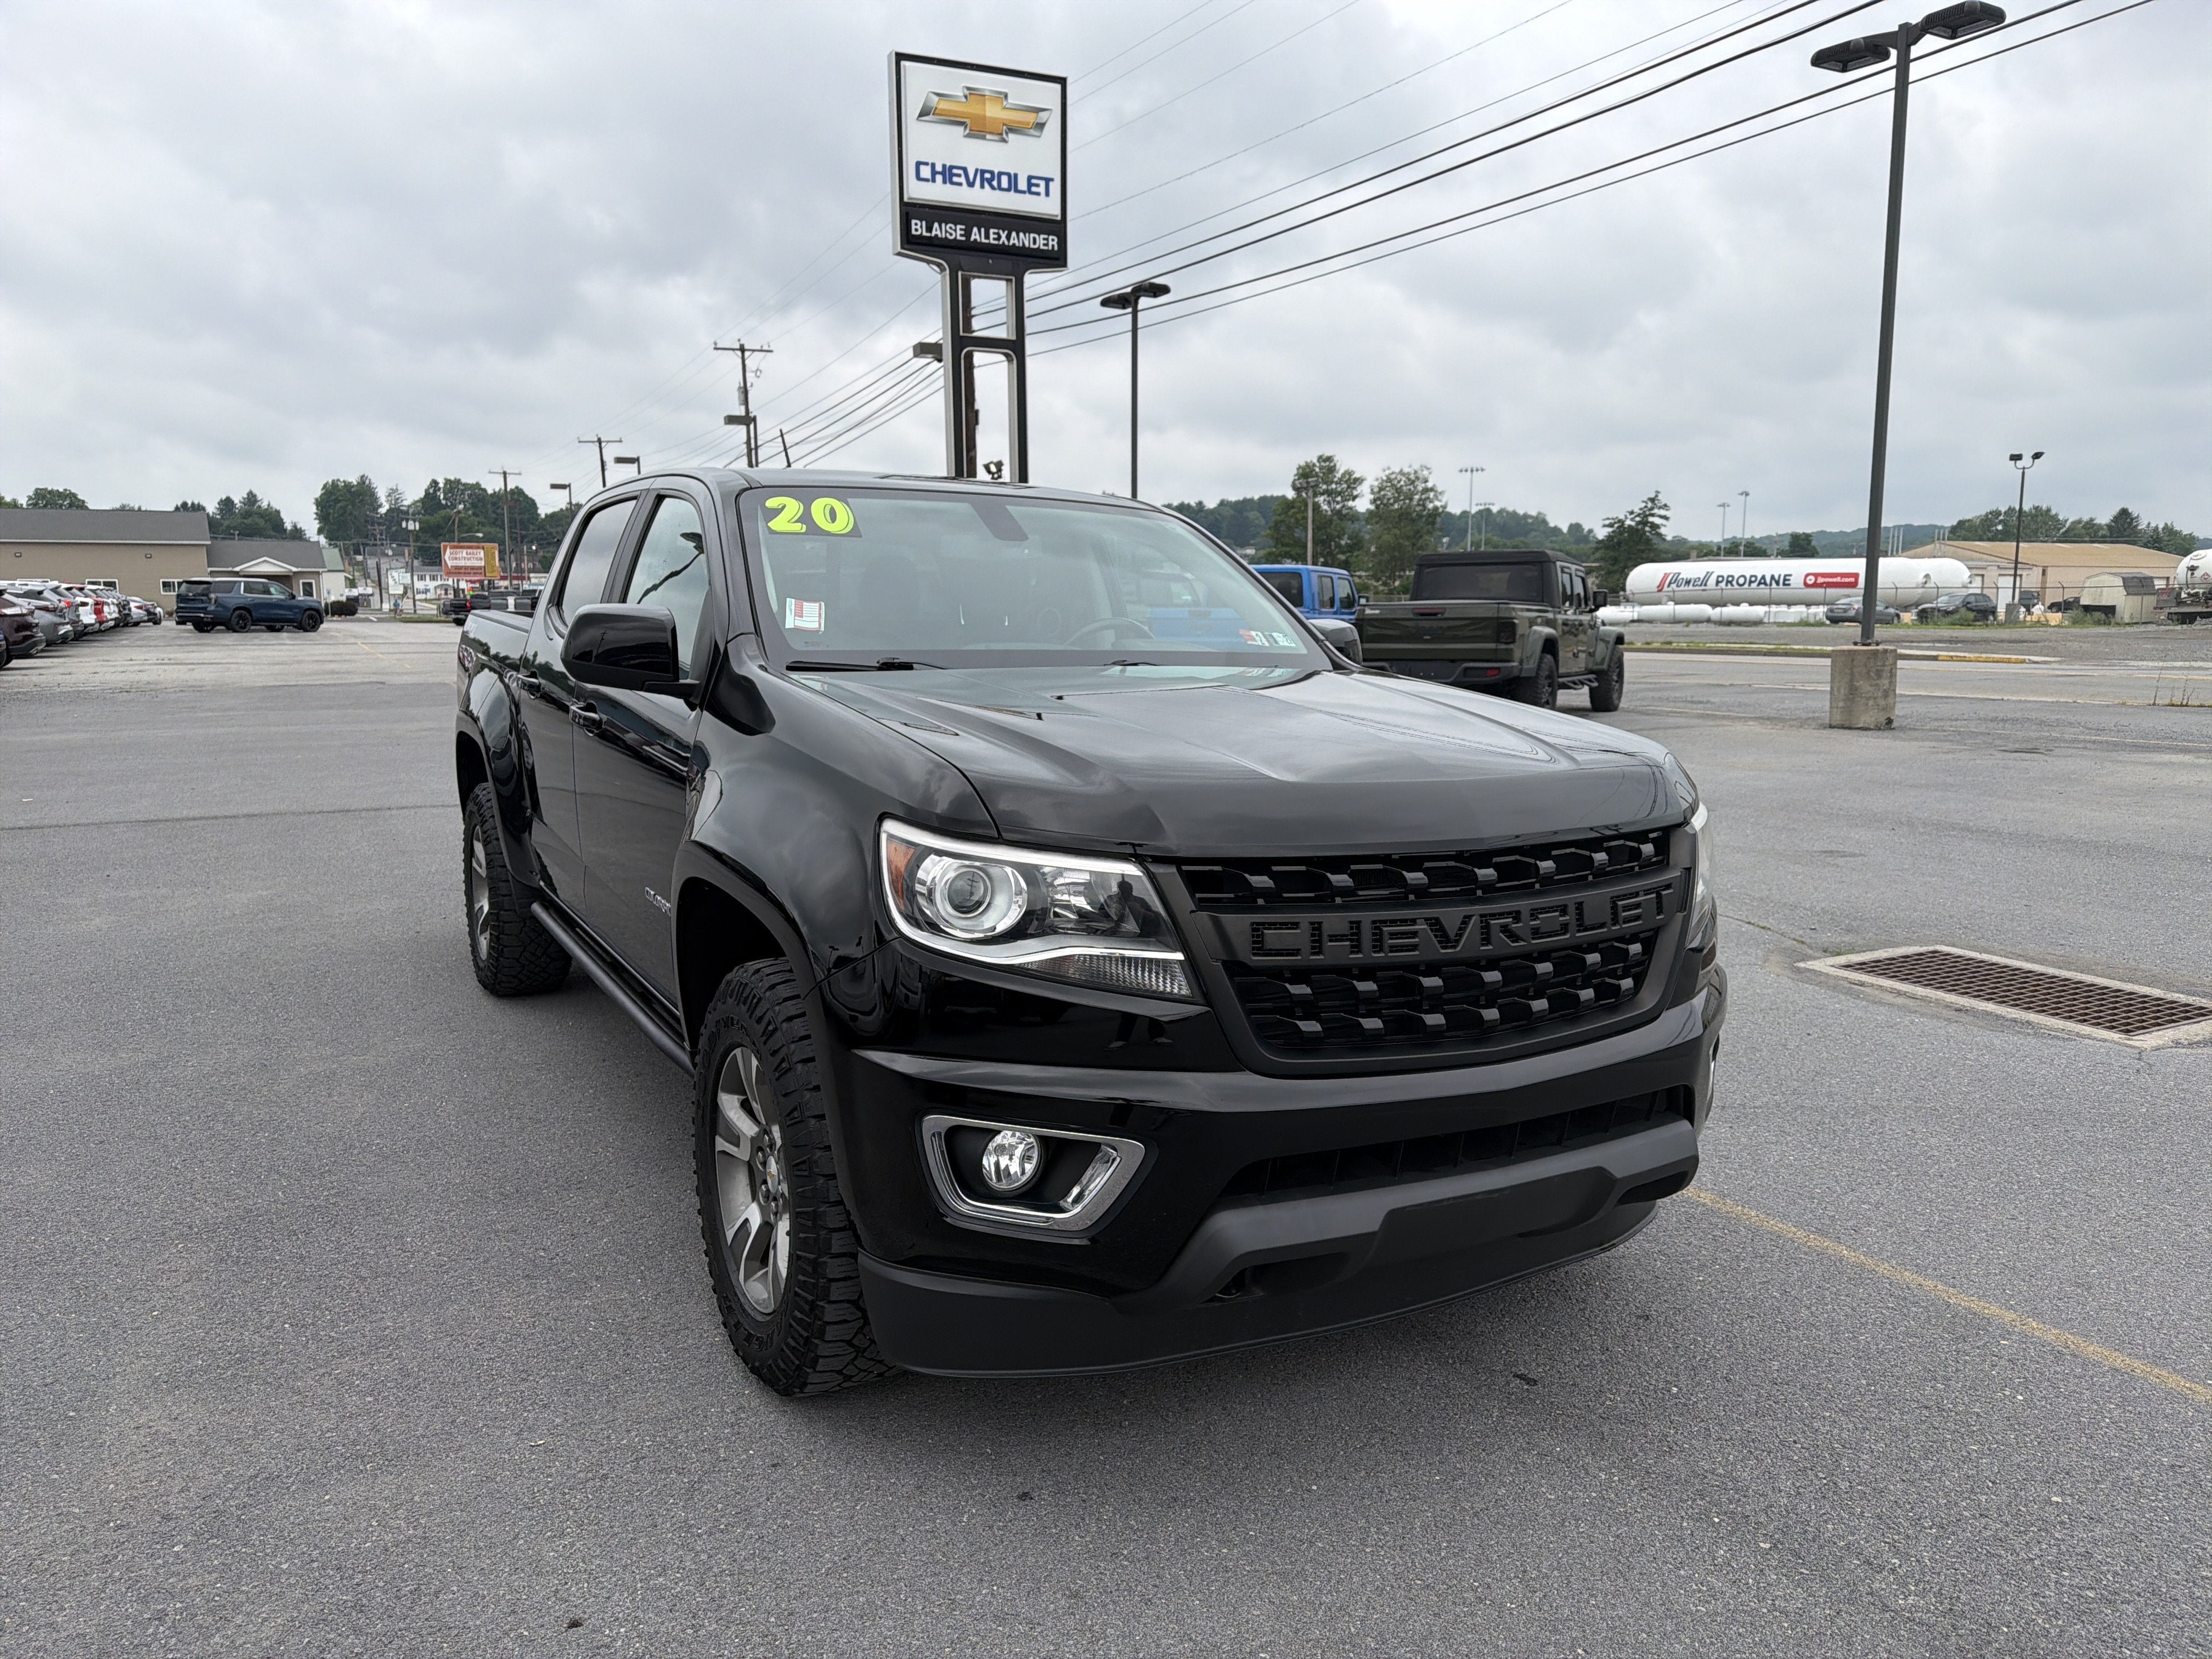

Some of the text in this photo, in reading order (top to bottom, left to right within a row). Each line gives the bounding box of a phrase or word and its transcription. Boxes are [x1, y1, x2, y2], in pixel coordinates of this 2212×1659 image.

[915, 160, 1054, 197] CHEVROLET
[911, 219, 1058, 251] BLAISE ALEXANDER
[765, 496, 854, 534] 20
[1715, 574, 1793, 587] PROPANE
[1250, 883, 1674, 960] CHEVROLET
